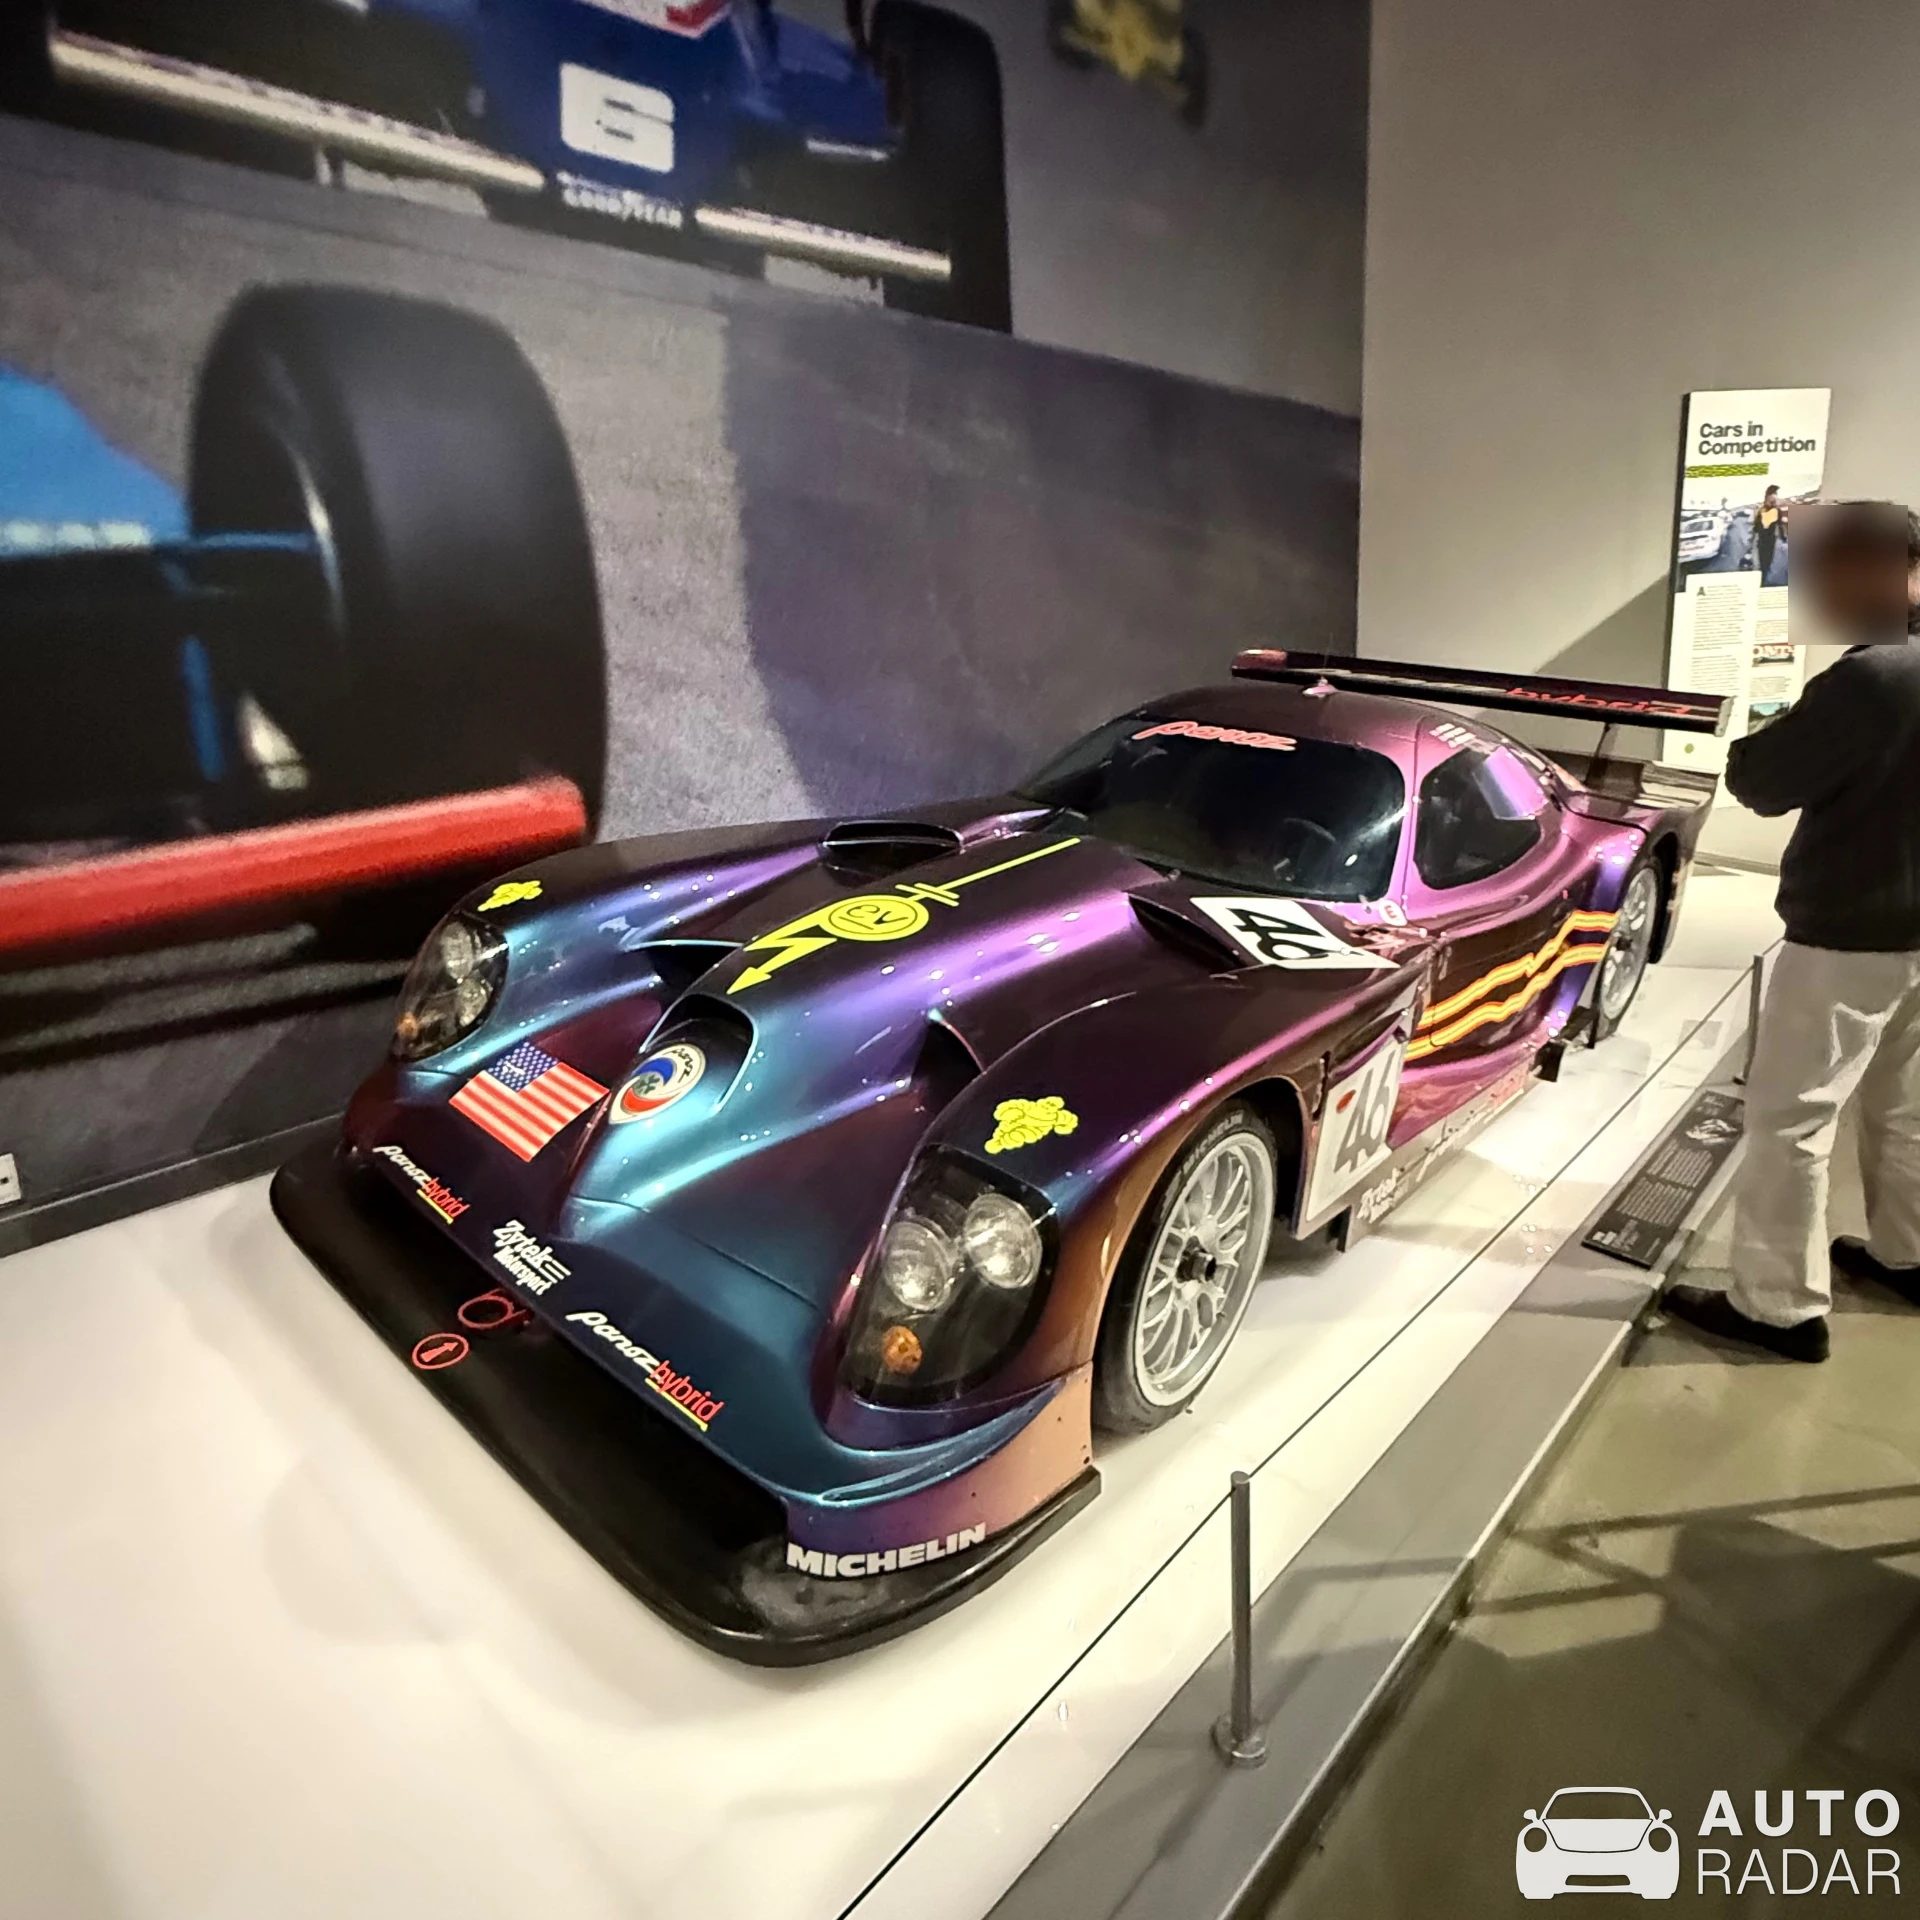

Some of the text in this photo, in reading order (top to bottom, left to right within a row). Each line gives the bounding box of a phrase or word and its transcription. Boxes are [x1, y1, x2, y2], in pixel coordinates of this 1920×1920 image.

[560, 62, 674, 174] 6
[1698, 436, 1816, 457] Competition
[1700, 420, 1764, 438] Cars in
[1505, 687, 1692, 714] hybrid
[1334, 1048, 1397, 1173] 46
[492, 1219, 554, 1270] Zytek
[493, 1247, 553, 1297] Motorsport
[786, 1521, 987, 1578] MICHELIN
